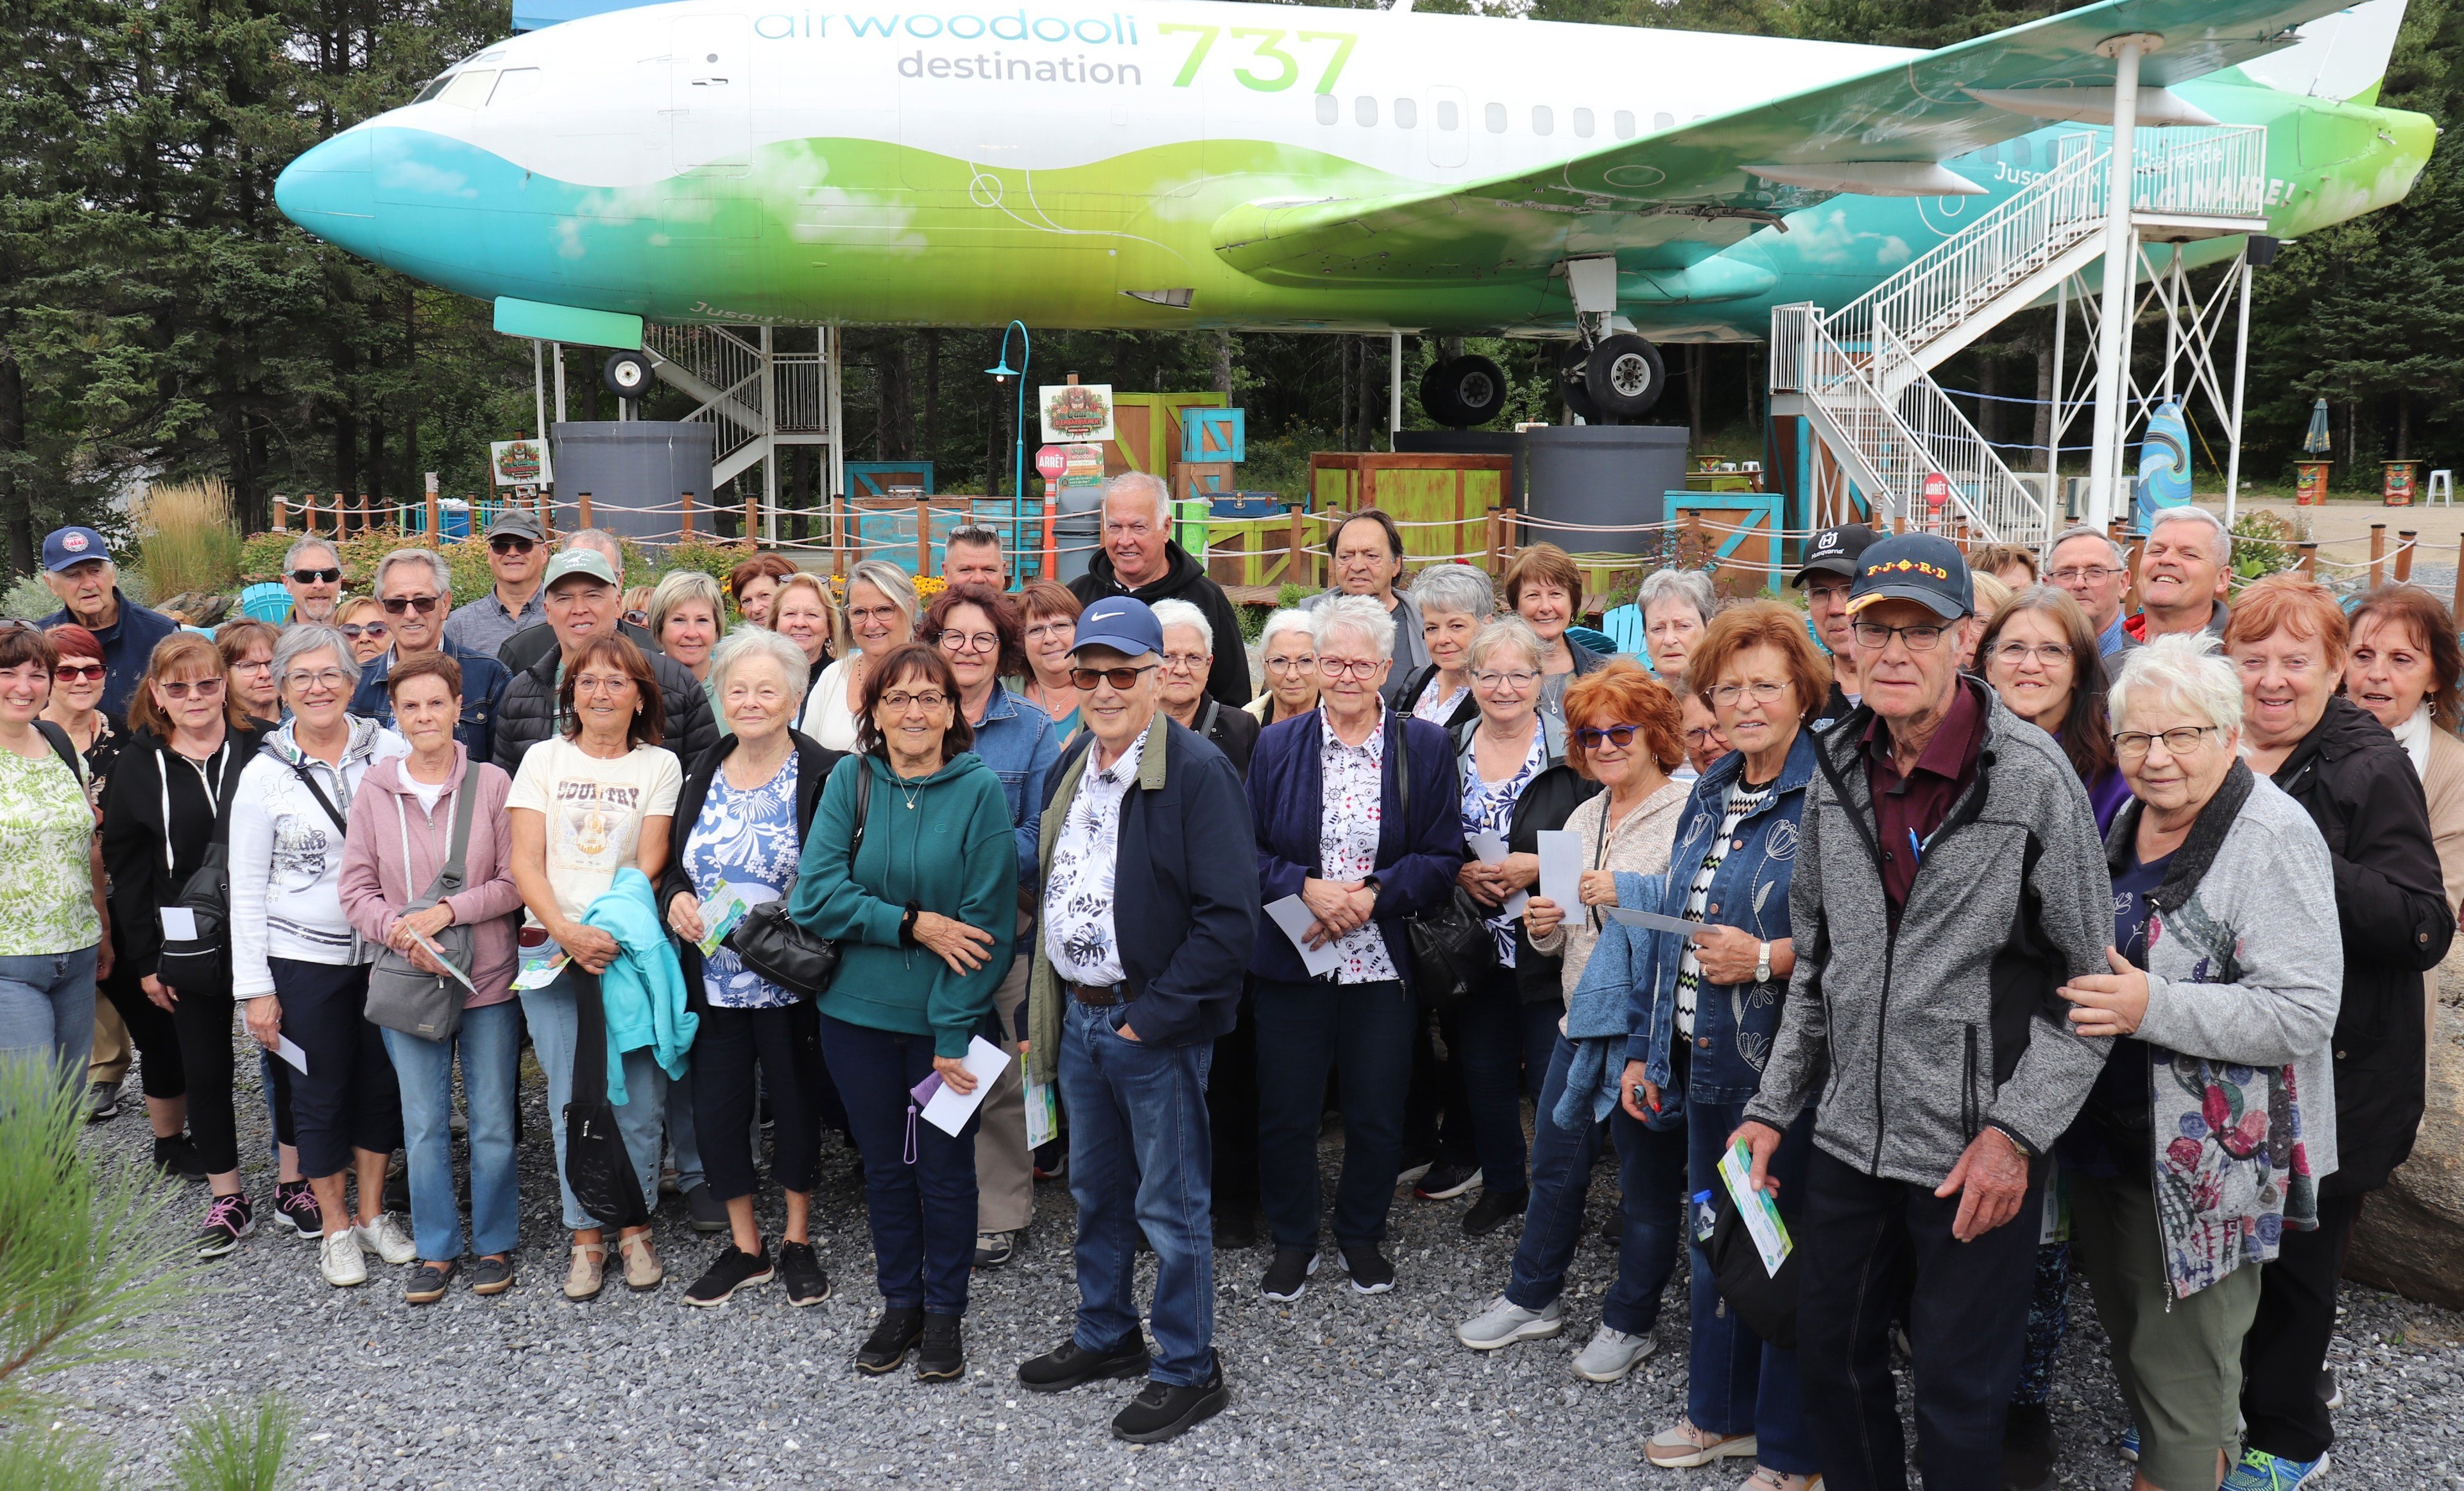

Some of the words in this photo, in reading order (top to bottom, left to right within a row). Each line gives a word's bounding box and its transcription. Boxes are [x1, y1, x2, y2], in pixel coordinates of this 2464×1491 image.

[898, 50, 1142, 85] destination
[1157, 23, 1358, 94] 737
[1039, 454, 1064, 468] ARRÊT
[1926, 481, 1946, 496] ARRÊT
